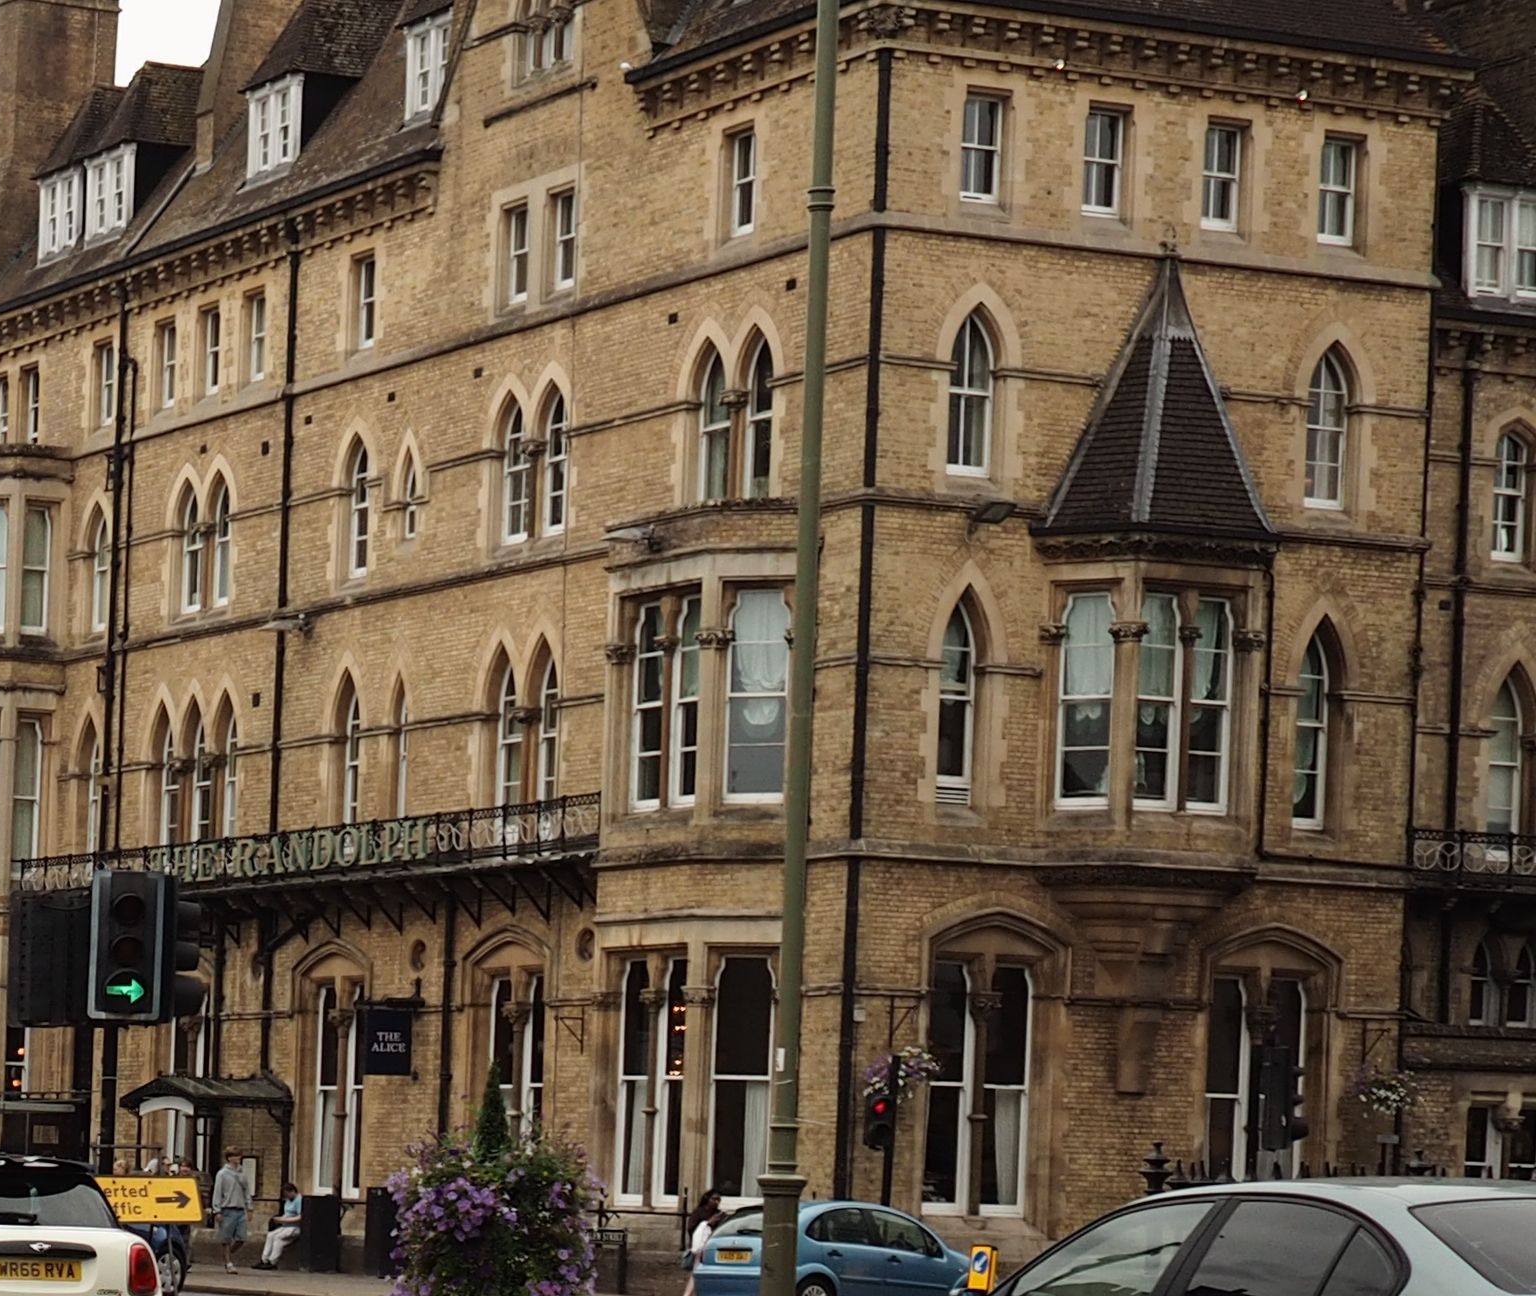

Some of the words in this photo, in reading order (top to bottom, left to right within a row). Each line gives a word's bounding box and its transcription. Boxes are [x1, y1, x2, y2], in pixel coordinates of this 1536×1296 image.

[149, 842, 219, 883] THE
[232, 818, 431, 878] RANDOLPH
[376, 1031, 402, 1042] THE
[371, 1042, 407, 1053] ALICE
[104, 1185, 149, 1198] erted
[113, 1201, 143, 1215] ffic
[45, 1262, 75, 1278] RVA
